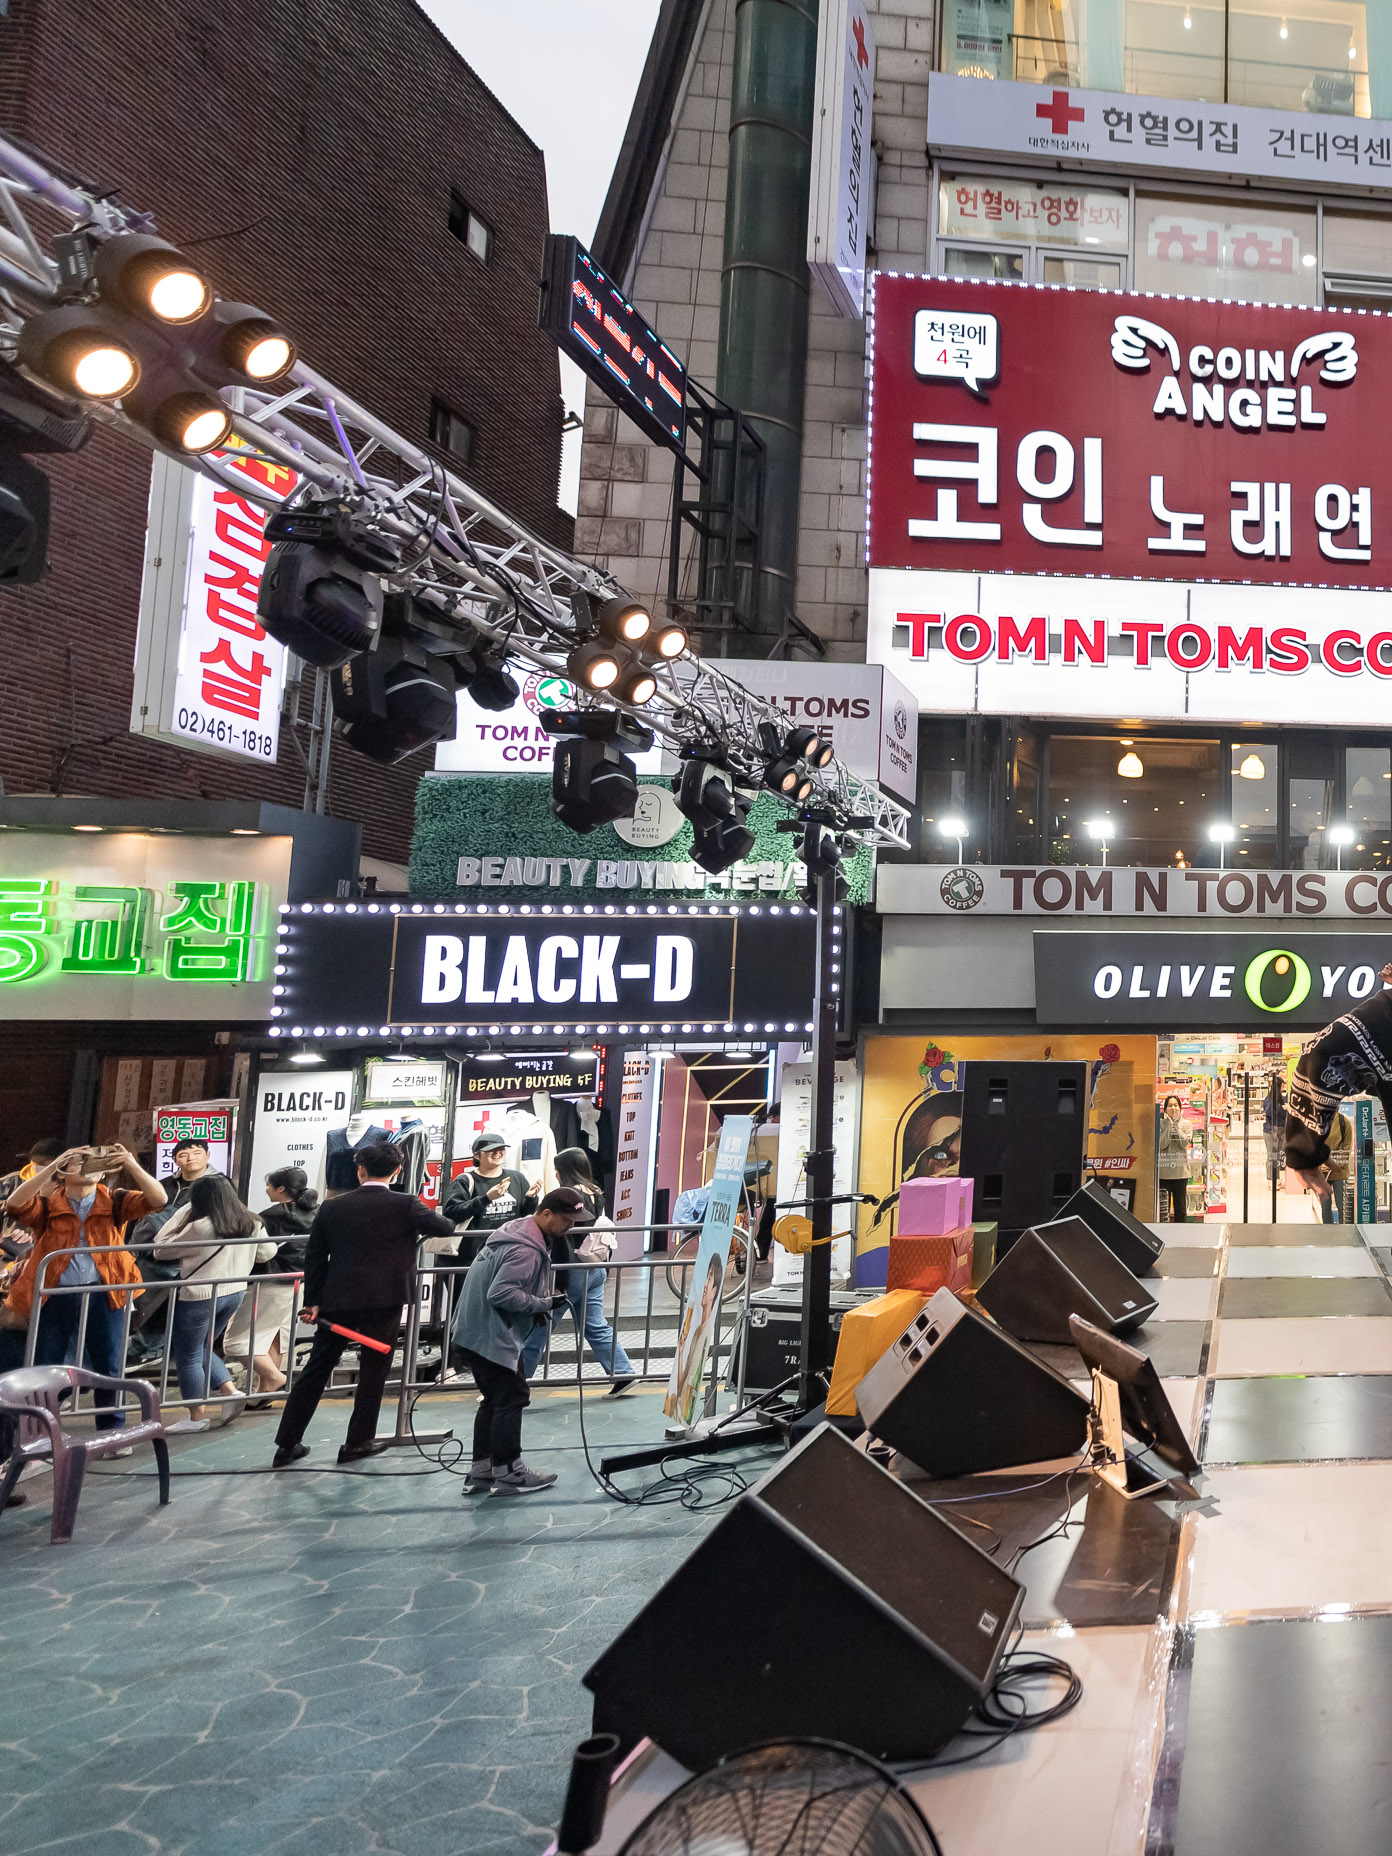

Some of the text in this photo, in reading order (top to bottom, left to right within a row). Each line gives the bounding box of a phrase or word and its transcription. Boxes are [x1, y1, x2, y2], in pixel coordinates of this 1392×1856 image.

[1103, 107, 1238, 154] 헌혈의집
[1028, 136, 1090, 152] 대한적십자사
[927, 321, 986, 345] 천원에
[1189, 345, 1285, 382] COIN
[1153, 376, 1327, 428] ANGEL
[908, 422, 1103, 546] 코인
[895, 611, 1048, 662] TOM
[1063, 618, 1106, 665] N
[1120, 621, 1310, 674] TOMS
[178, 708, 272, 756] 02)461-1818
[476, 724, 529, 741] TOM
[890, 753, 908, 773] COFFEE
[455, 857, 592, 887] BEAUTY
[942, 872, 956, 889] TOM
[965, 870, 982, 891] TOMS
[944, 894, 980, 909] COFFEE
[1000, 869, 1113, 911] TOM
[1134, 871, 1168, 912] N
[1185, 872, 1327, 914] TOMS
[421, 935, 694, 1003] BLACK-D
[1093, 965, 1235, 999] OLIVE
[468, 1073, 593, 1092] BEAUTY BUYING 5F
[263, 1091, 346, 1113] BLACK-D
[160, 1115, 228, 1141] 영동교집
[626, 1111, 636, 1123] TOP
[287, 1143, 314, 1152] CLOTHES
[618, 1149, 639, 1163] BOTTOM
[616, 1207, 633, 1222] SHOES
[711, 1201, 731, 1227] TERRA
